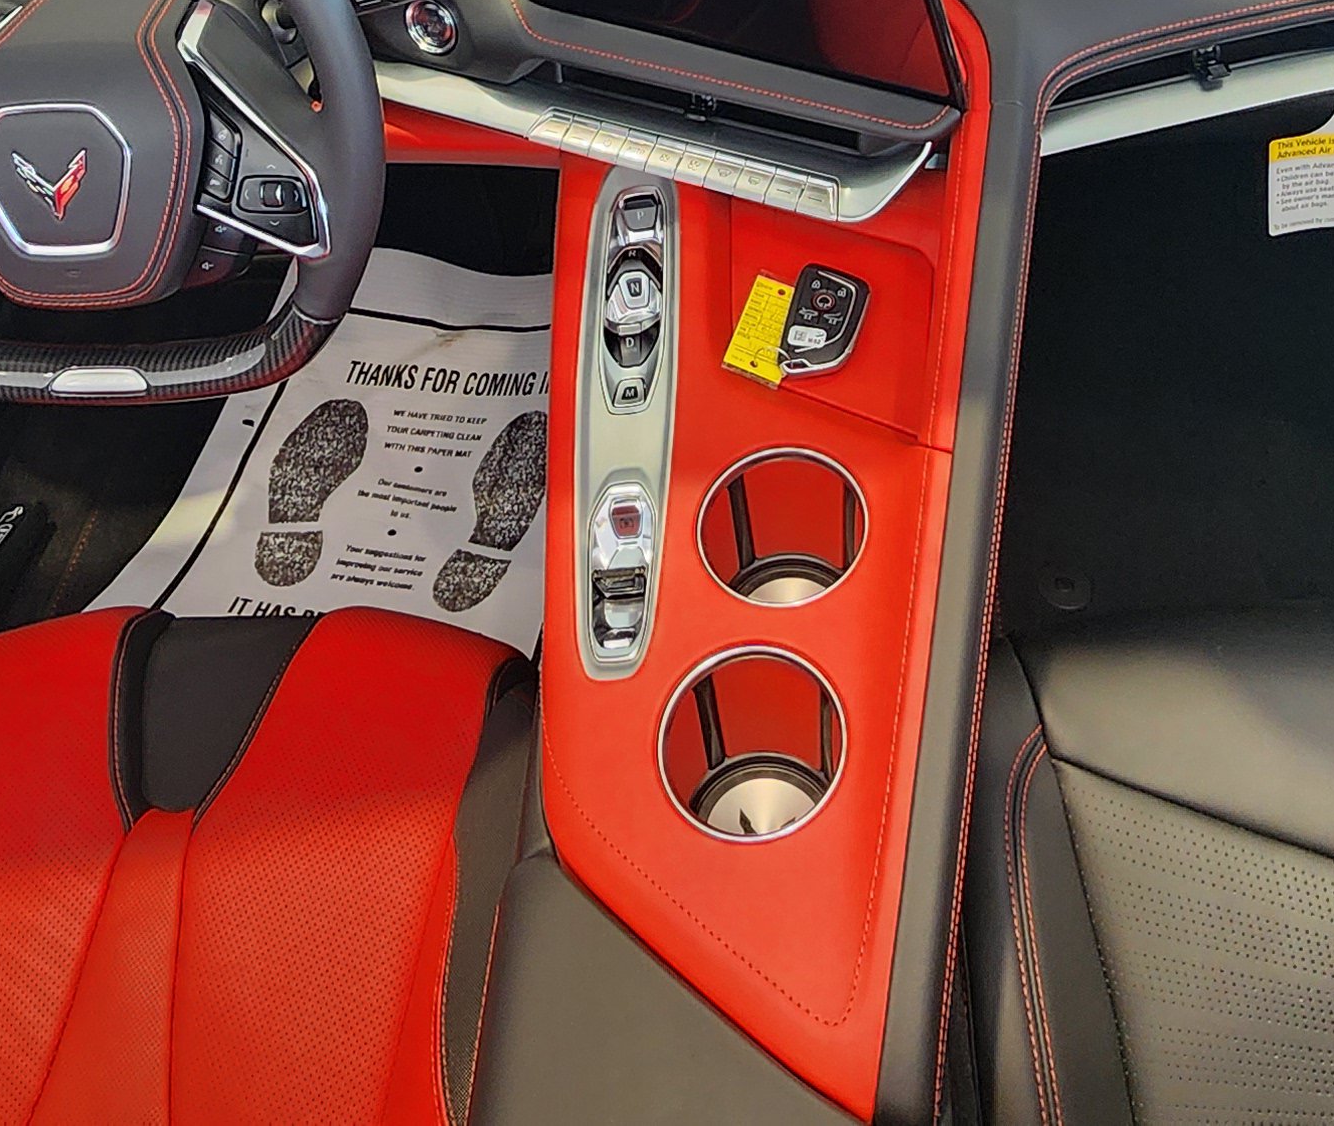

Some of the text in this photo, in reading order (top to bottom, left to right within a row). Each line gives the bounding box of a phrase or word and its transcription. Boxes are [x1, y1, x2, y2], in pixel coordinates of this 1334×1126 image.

[1277, 141, 1293, 149] This
[1296, 137, 1326, 146] Vehicle
[1277, 147, 1317, 159] Advanced
[637, 211, 644, 220] P
[630, 282, 640, 293] N
[626, 337, 635, 348] D
[346, 361, 418, 389] THANKS
[420, 367, 460, 394] FOR
[463, 372, 537, 396] COMING
[625, 388, 635, 397] M
[393, 409, 406, 417] WE
[407, 412, 428, 420] HAVE
[430, 414, 453, 422] TRIED
[467, 417, 487, 425] KEEP
[387, 425, 482, 441] YOUR CARPETING CLEAN
[384, 442, 473, 458] WITH THIS PAPER MAT
[392, 495, 430, 508] important
[430, 503, 457, 513] people
[346, 544, 364, 553] Your
[330, 573, 345, 581] are
[346, 576, 374, 586] always
[227, 596, 253, 615] IT
